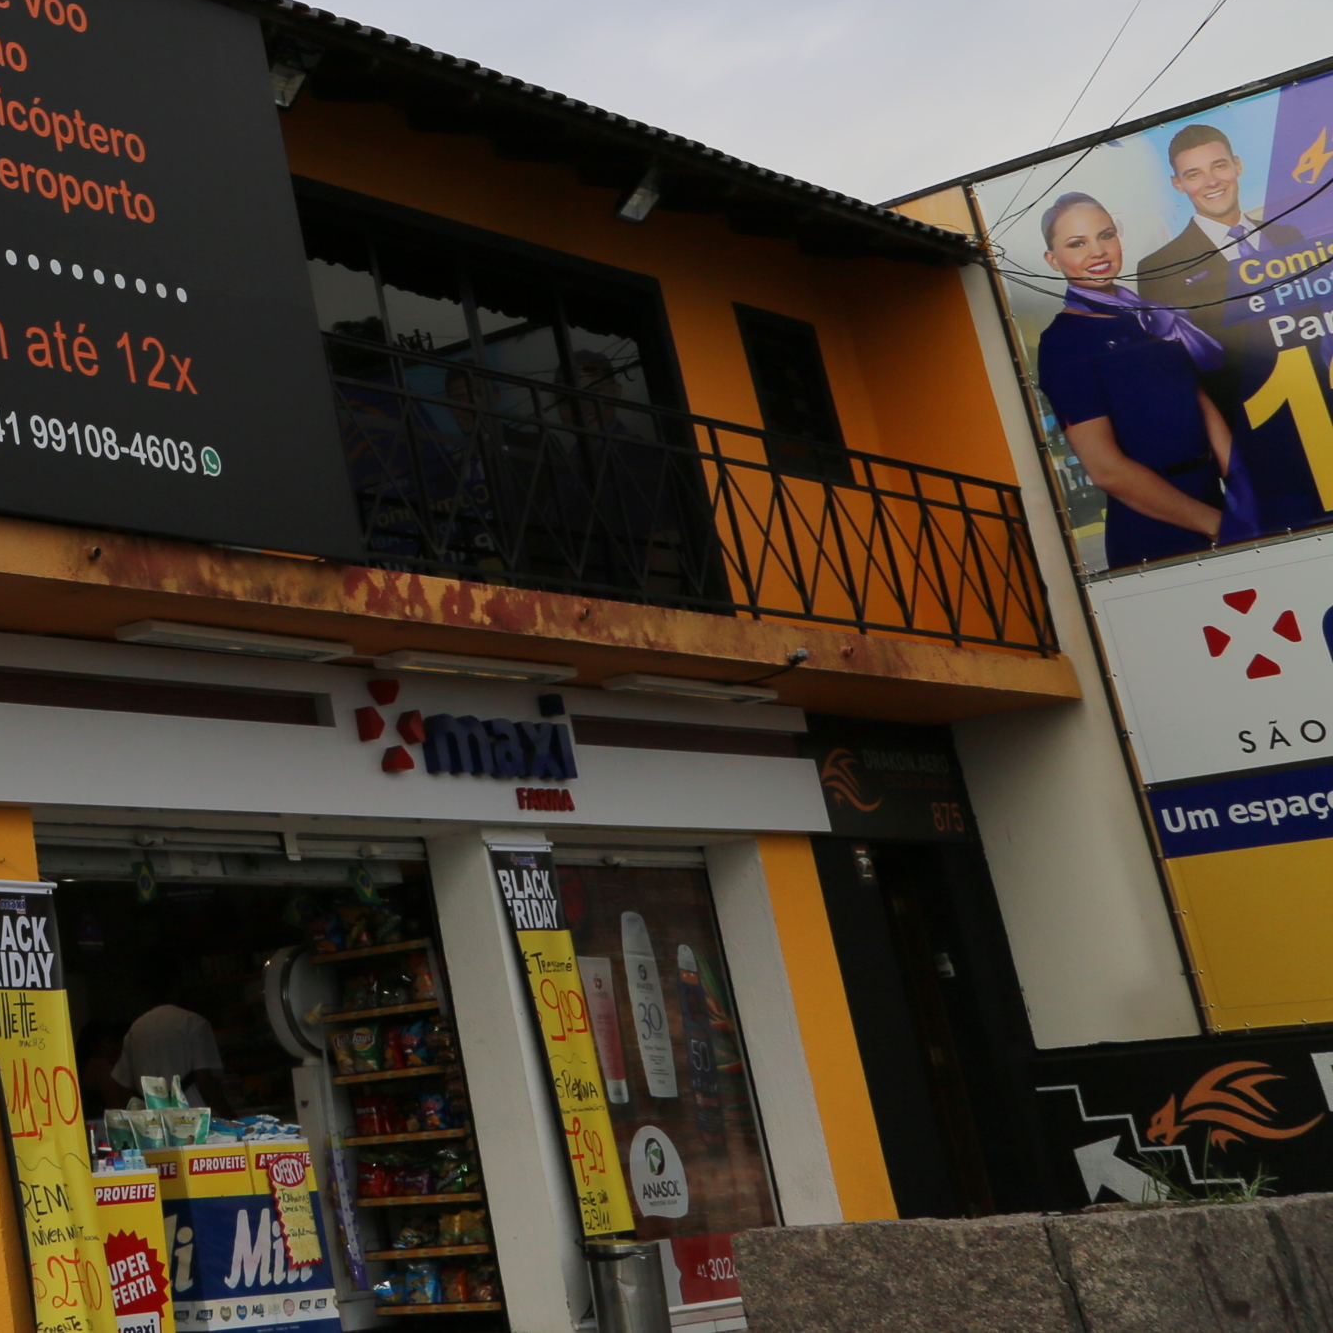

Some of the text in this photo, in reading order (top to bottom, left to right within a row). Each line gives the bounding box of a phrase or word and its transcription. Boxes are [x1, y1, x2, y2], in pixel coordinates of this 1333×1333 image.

[1249, 271, 1333, 313] e Pilo
[25, 320, 99, 377] até
[116, 331, 199, 395] 12x
[29, 415, 197, 474] 99108-4603
[422, 693, 578, 780] maxi
[1238, 720, 1326, 754] SÃO
[515, 788, 575, 812] FARMA
[930, 801, 964, 832] 875
[1161, 806, 1220, 833] Um
[497, 869, 554, 900] BLACK
[638, 1002, 662, 1041] 30
[691, 1039, 710, 1072] 50
[192, 1155, 245, 1173] APROVEITE
[272, 1157, 305, 1184] OFERTA
[95, 1184, 156, 1203] PROVEITE
[642, 1180, 681, 1199] ANASOL
[697, 1257, 738, 1281] 41 302
[111, 1275, 158, 1309] FERTA
